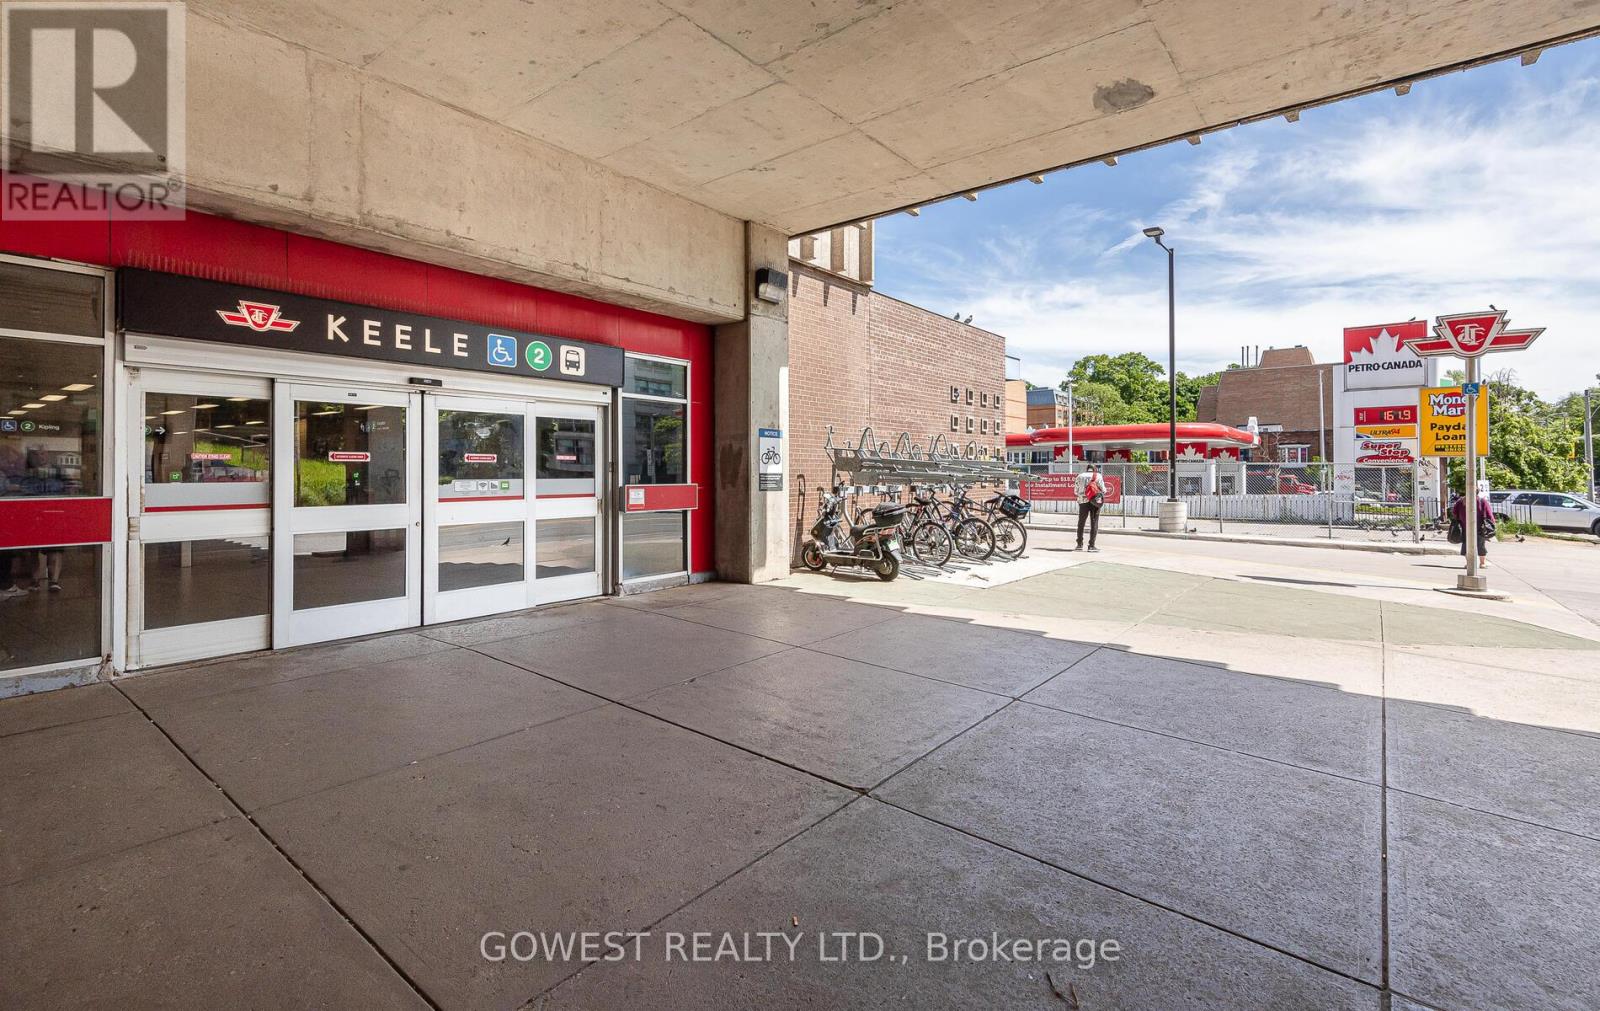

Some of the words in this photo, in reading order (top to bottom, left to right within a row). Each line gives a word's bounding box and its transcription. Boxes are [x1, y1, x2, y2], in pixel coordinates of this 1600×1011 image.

[327, 313, 469, 357] KEELE
[534, 348, 545, 364] 2
[1432, 405, 1467, 416] Mar
[1430, 422, 1466, 432] Payda
[1435, 432, 1466, 441] Loan
[1361, 441, 1401, 450] Super
[1380, 448, 1410, 457] Stop
